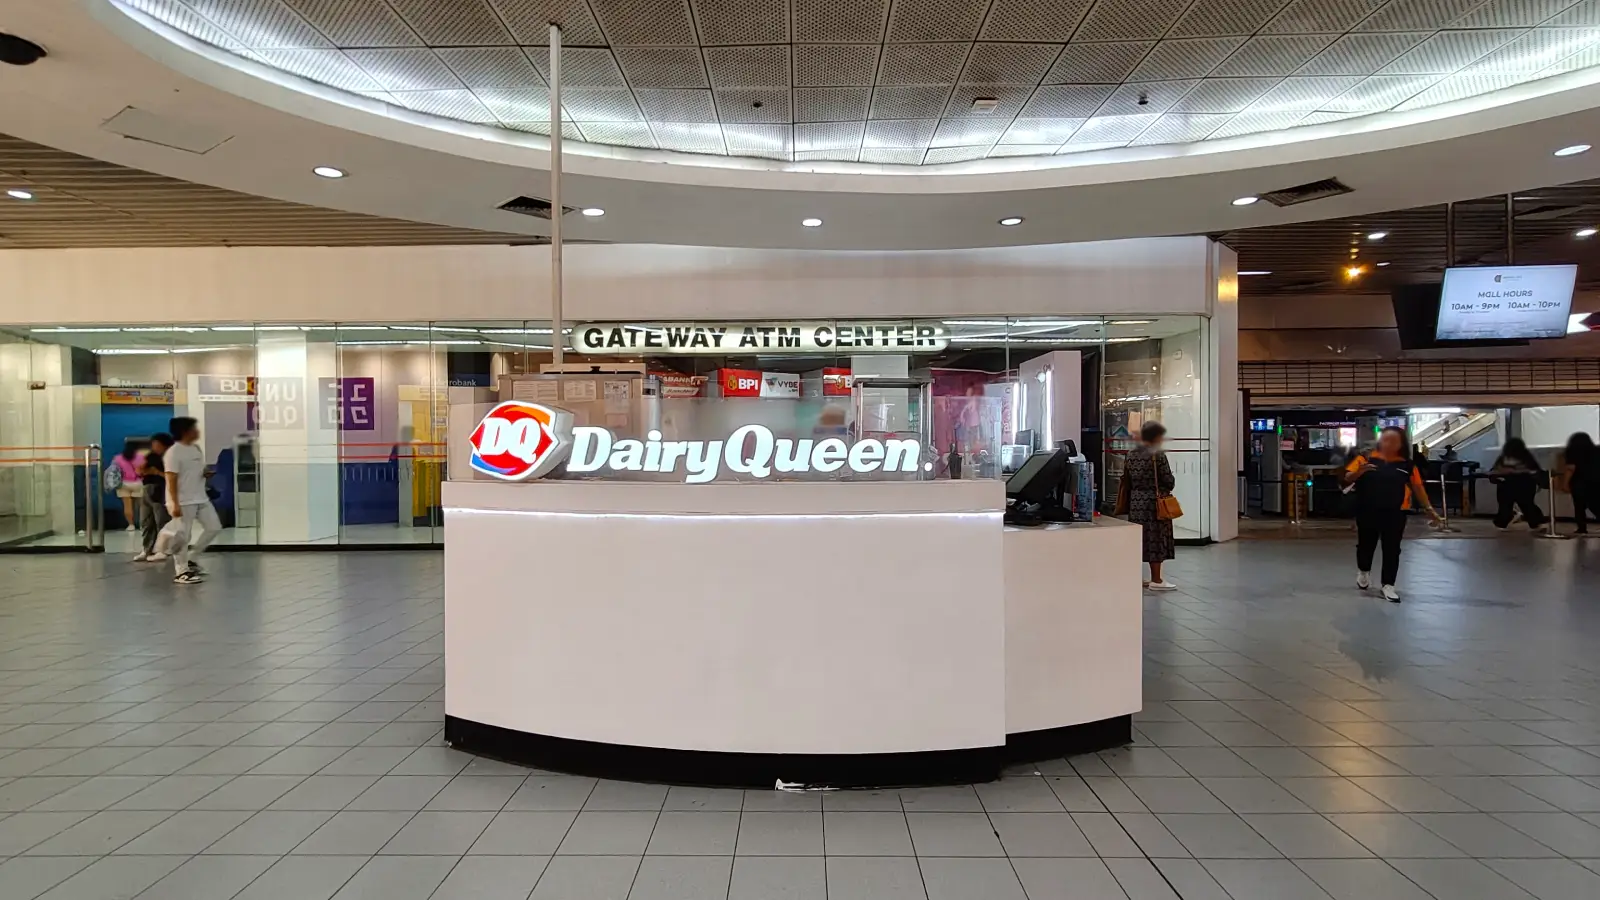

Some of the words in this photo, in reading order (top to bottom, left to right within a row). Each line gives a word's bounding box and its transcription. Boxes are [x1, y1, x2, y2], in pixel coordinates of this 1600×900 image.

[1481, 302, 1500, 310] 9PM
[1508, 301, 1530, 309] 10AM
[584, 327, 727, 348] GATEWAY
[739, 327, 801, 348] ATM
[814, 326, 936, 348] CENTER
[738, 379, 758, 390] BPI
[778, 381, 798, 389] VYBE
[478, 416, 537, 465] DQ
